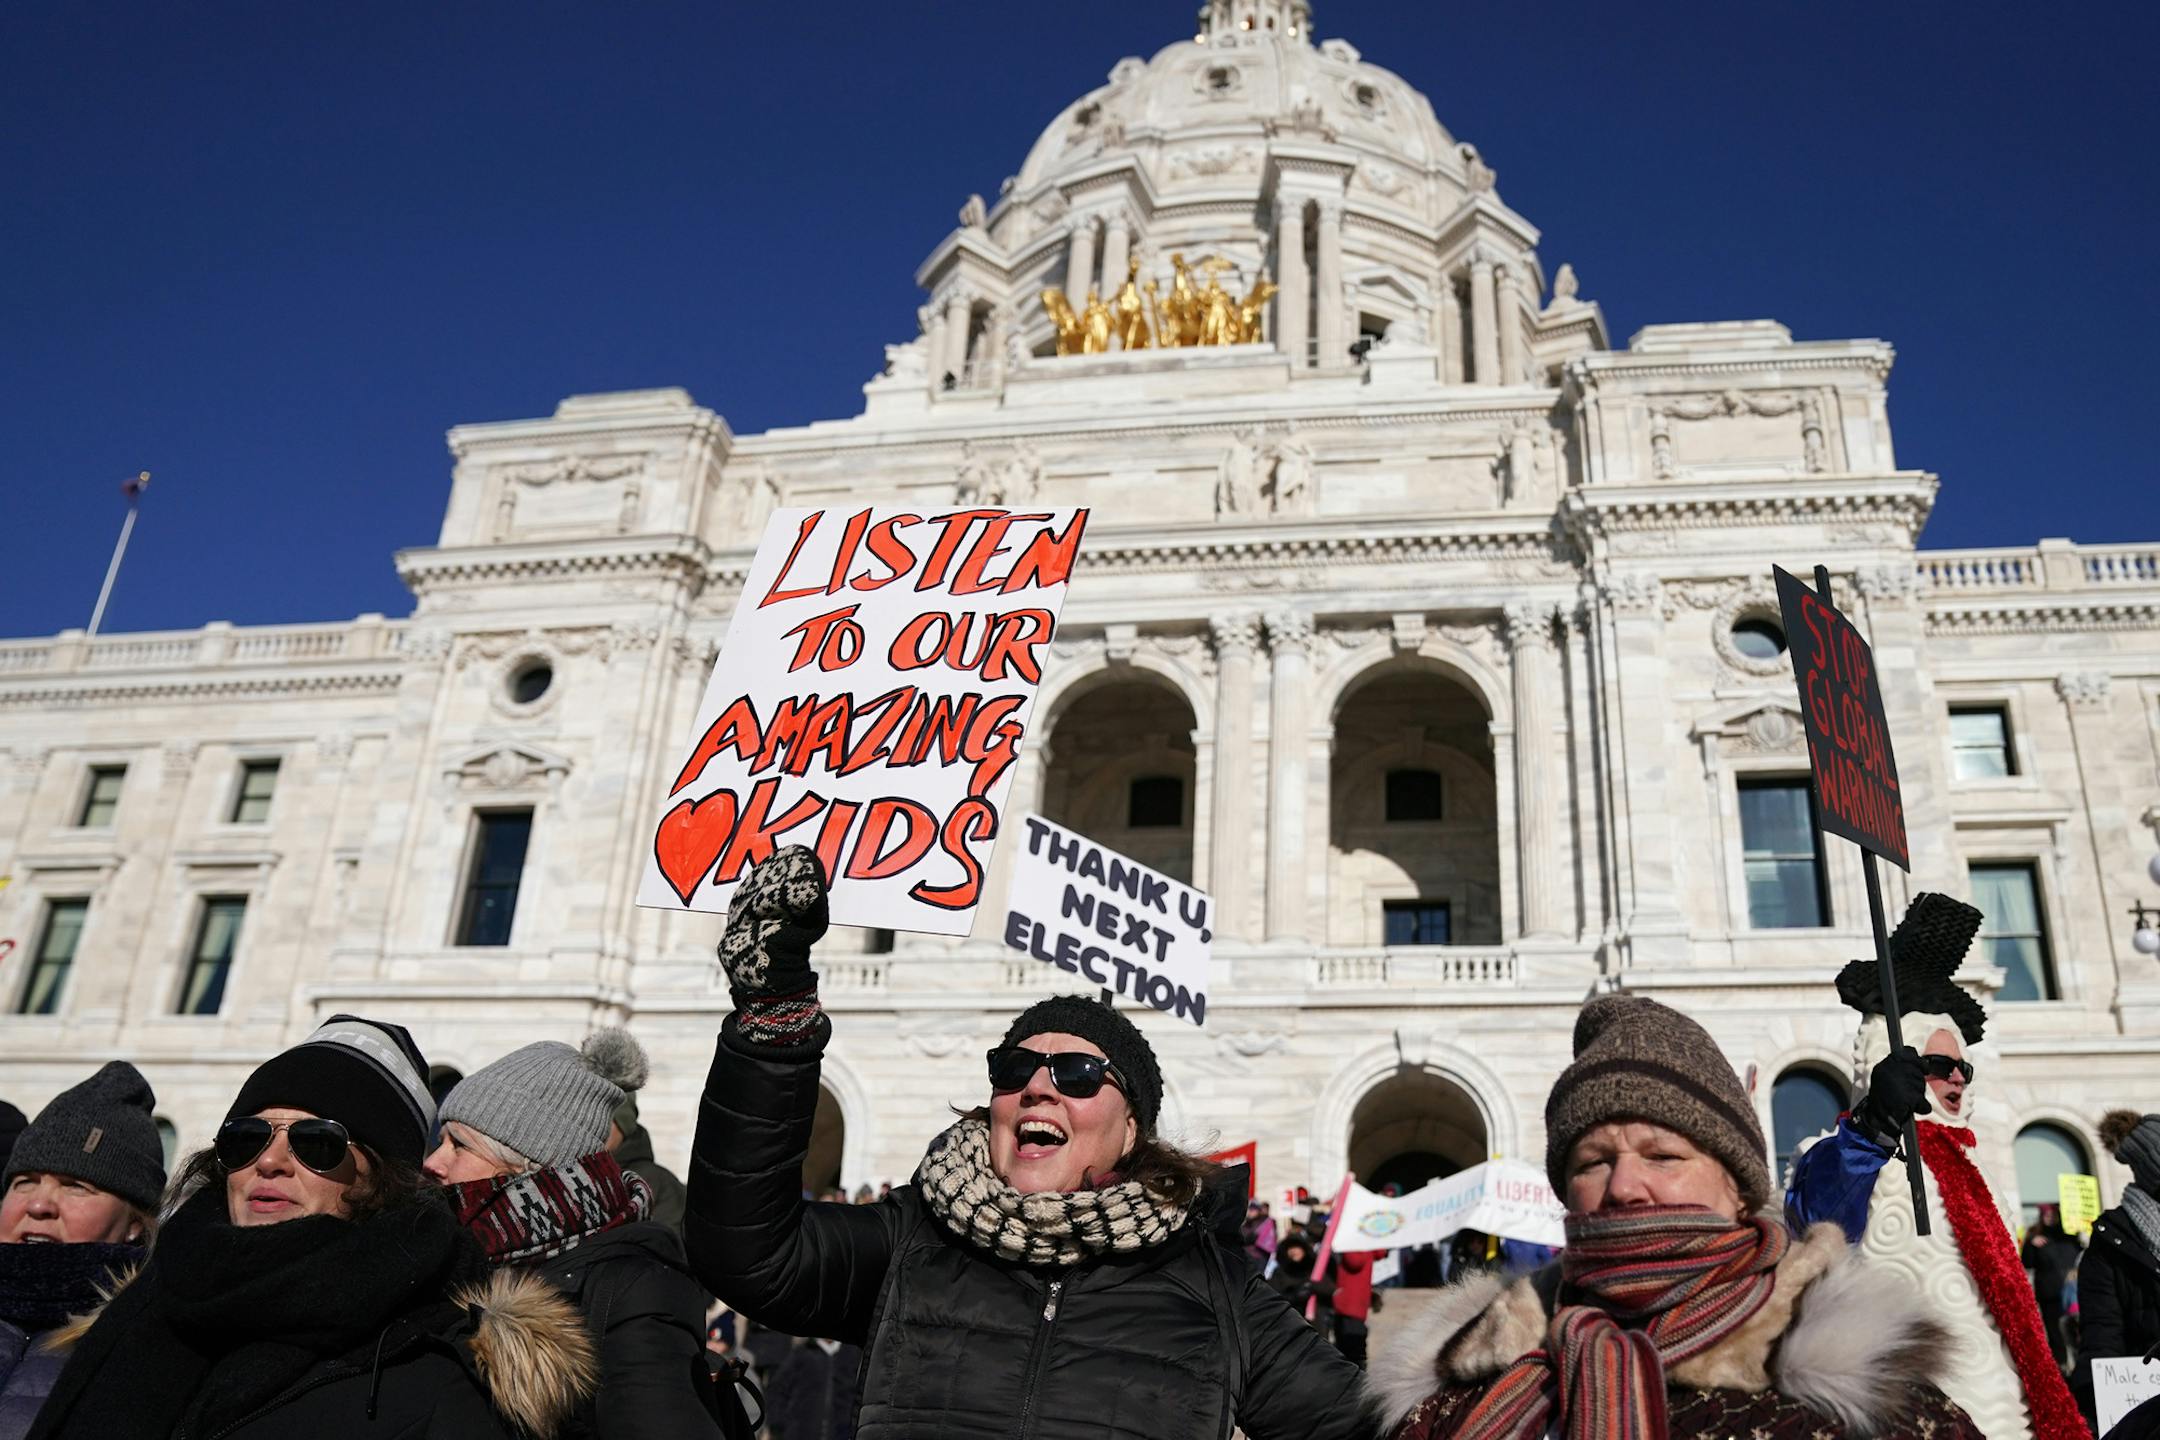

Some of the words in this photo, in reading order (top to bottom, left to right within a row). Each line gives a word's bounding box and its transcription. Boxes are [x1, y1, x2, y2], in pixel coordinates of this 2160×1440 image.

[758, 507, 1091, 609] LISTEN
[781, 604, 865, 673] TO
[888, 608, 1055, 685] OUR
[1801, 594, 1868, 700] STOP
[668, 685, 1028, 800] AMAZING
[1807, 669, 1897, 791] GLOBAL
[713, 777, 999, 910] KIDS
[1811, 742, 1908, 858] WARMING
[1026, 817, 1169, 914] THANK
[1004, 911, 1206, 1026] ELECTION
[1061, 884, 1175, 962] NEXT
[1415, 1183, 1485, 1221] EQUALITY
[1496, 1177, 1554, 1205] LIBERT
[2105, 1364, 2140, 1386] Male
